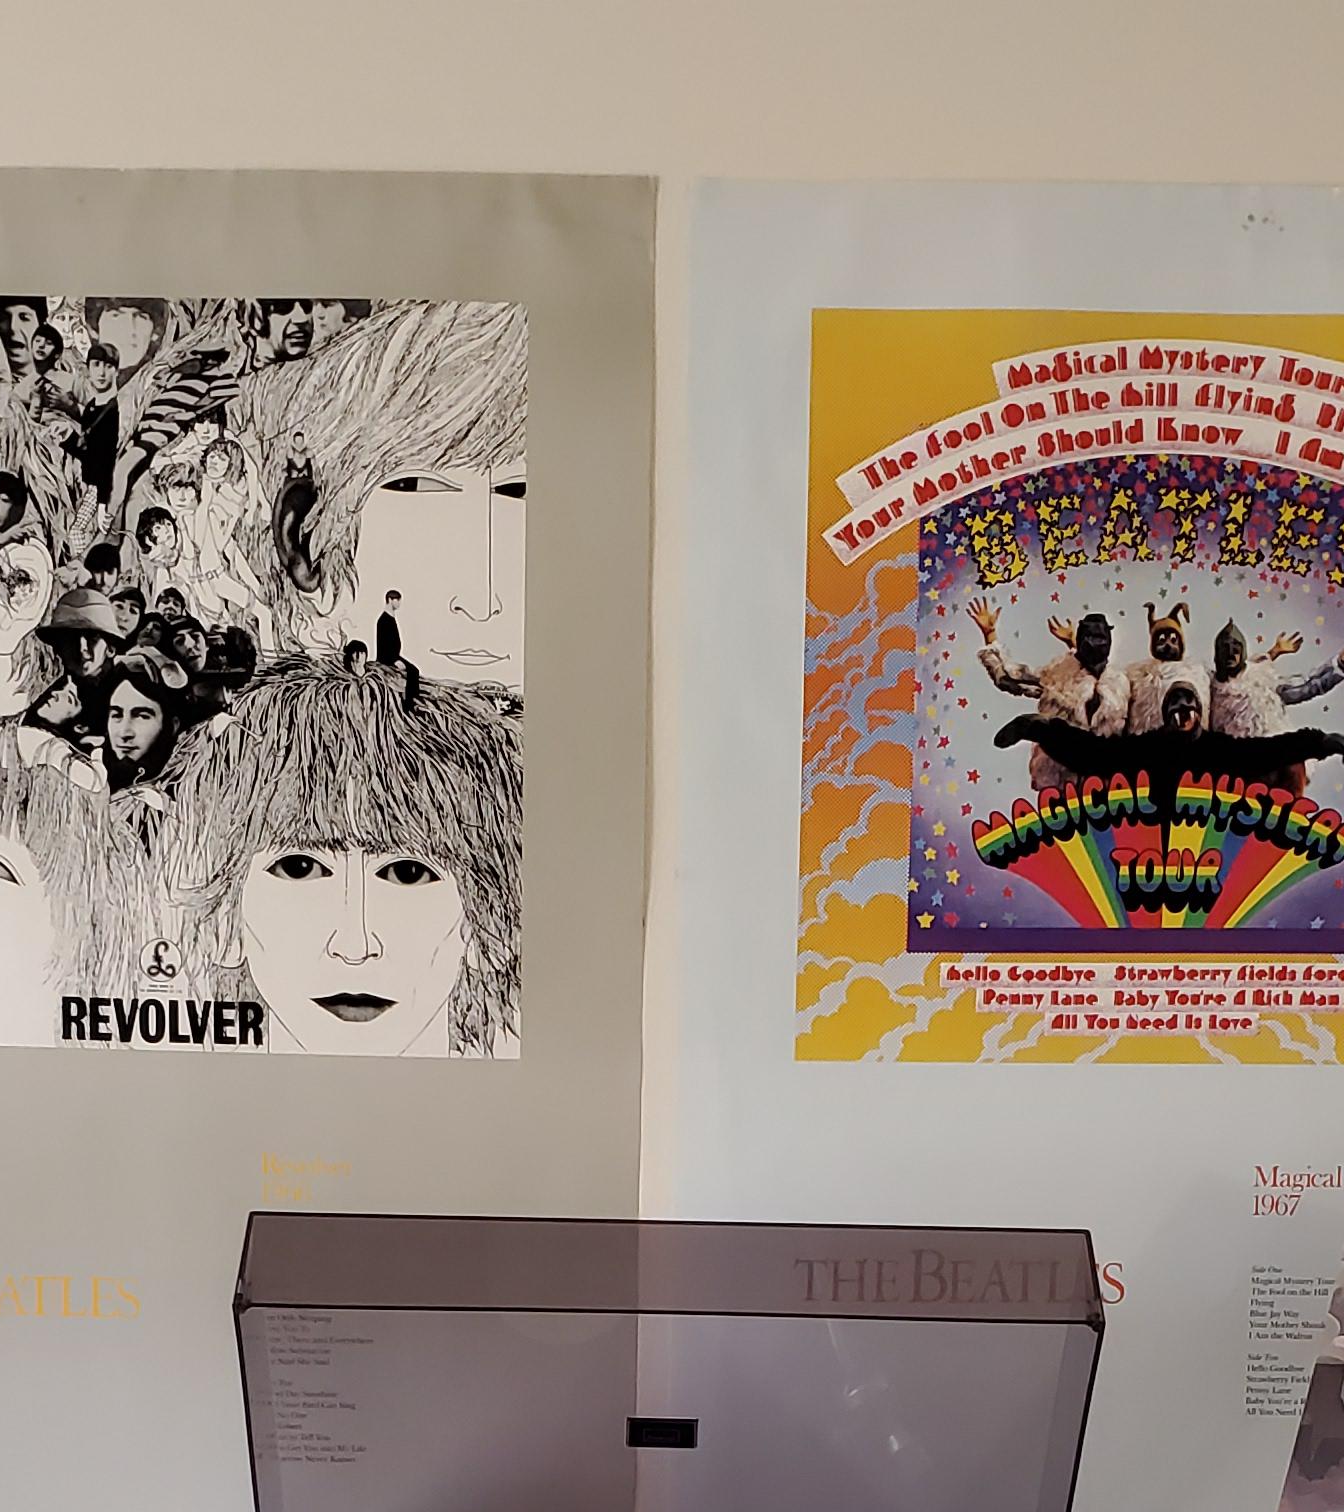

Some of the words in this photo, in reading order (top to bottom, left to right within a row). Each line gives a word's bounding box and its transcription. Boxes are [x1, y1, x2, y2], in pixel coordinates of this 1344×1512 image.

[1008, 347, 1127, 389] Magical
[1139, 345, 1265, 379] Mystery
[858, 451, 918, 490] The
[1001, 401, 1046, 427] On
[1050, 388, 1110, 416] The
[1195, 382, 1296, 422] Flying
[833, 498, 904, 550] Your
[913, 444, 1027, 506] Mother
[1038, 418, 1144, 457] Should
[1157, 417, 1243, 446] Know
[1276, 431, 1291, 454] I
[1299, 438, 1344, 470] Am
[971, 769, 1158, 869] MAGICAL
[1111, 846, 1222, 894] TOUR
[1007, 965, 1096, 985] Goodbye
[1114, 965, 1230, 986] Strawberry
[61, 995, 264, 1046] REVOLVER
[983, 990, 1044, 1010] Penny
[1051, 990, 1098, 1007] Lane
[1113, 990, 1157, 1010] Baby
[1252, 990, 1292, 1007] Rich
[1300, 991, 1340, 1007] Man
[1084, 1014, 1120, 1030] You
[1208, 1014, 1253, 1030] Love
[1253, 1165, 1343, 1192] Magical
[1252, 1194, 1301, 1217] 1967
[794, 1257, 899, 1304] THE
